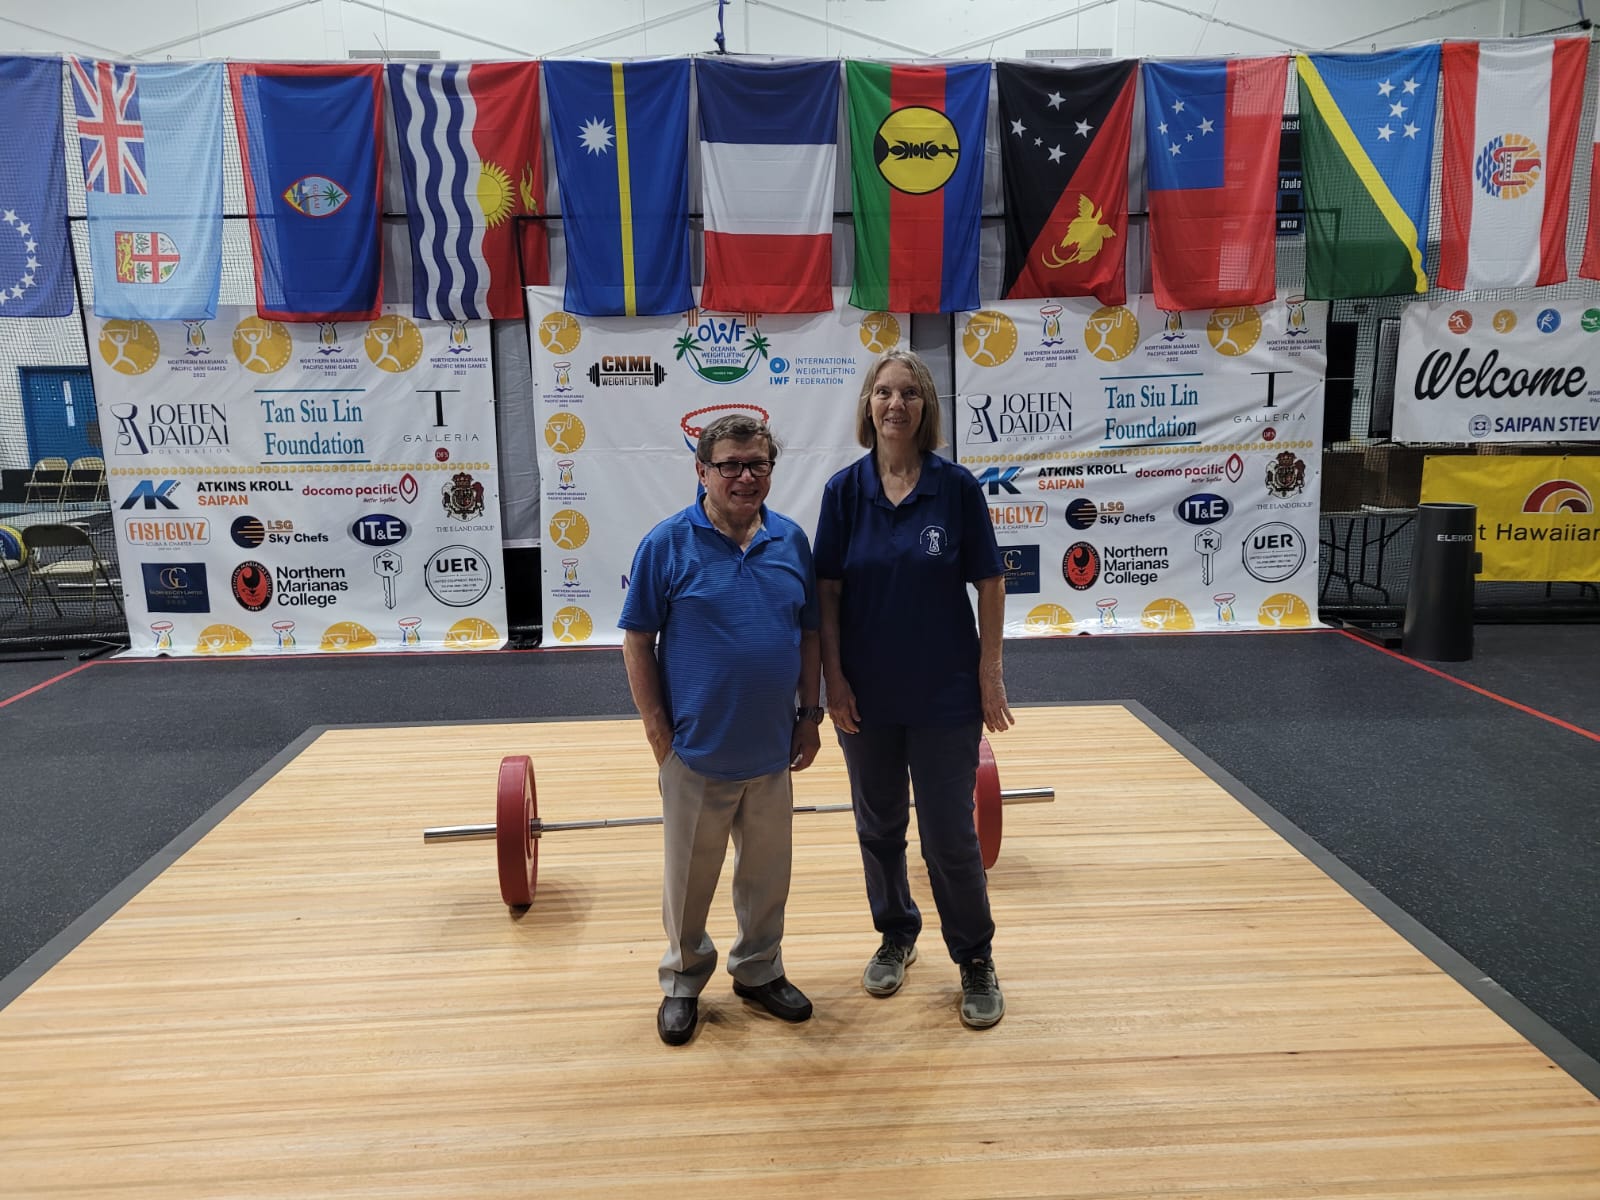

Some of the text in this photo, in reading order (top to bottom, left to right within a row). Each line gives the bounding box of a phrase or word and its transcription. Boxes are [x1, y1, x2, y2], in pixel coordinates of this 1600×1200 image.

[602, 356, 652, 372] CNMI
[602, 376, 654, 386] WEIGHTLIFTING
[770, 376, 790, 385] IWF
[1414, 347, 1588, 400] Welcome
[1104, 384, 1198, 408] Tan Siu Lin
[1250, 370, 1293, 407] T
[416, 390, 460, 427] T
[1000, 392, 1072, 414] JOETEN
[150, 403, 227, 425] JOETEN
[260, 399, 363, 423] Tan Siu Lin
[1000, 412, 1072, 434] DAIDAI
[1234, 414, 1306, 424] GALLERIA
[1494, 416, 1556, 432] SAIPAN
[148, 424, 230, 446] DAIDAI
[1104, 415, 1197, 440] Foundation
[264, 432, 365, 456] Foundation
[403, 434, 480, 442] GALLERIA
[1038, 464, 1127, 477] ATKINS KROLL
[1135, 464, 1224, 478] docomo pacific
[197, 481, 294, 492] ATKINS KROLL
[302, 484, 398, 498] docomo pacific
[1038, 479, 1084, 490] SAIPAN
[120, 480, 180, 510] AK
[198, 495, 248, 506] SAIPAN
[1100, 502, 1124, 512] LSG
[1184, 500, 1224, 519] IT&E
[267, 520, 294, 530] LSG
[1100, 513, 1156, 525] Sky Chefs
[128, 522, 208, 541] FISHGUYZ
[359, 520, 402, 541] IT&E
[268, 533, 329, 544] Sky Chefs
[1254, 534, 1294, 549] UER
[1104, 546, 1168, 558] Northern
[436, 558, 478, 573] UER
[1104, 558, 1169, 571] Marianas
[276, 566, 346, 579] Northern
[1104, 571, 1158, 586] College
[277, 580, 348, 592] Marianas
[278, 593, 337, 608] College
